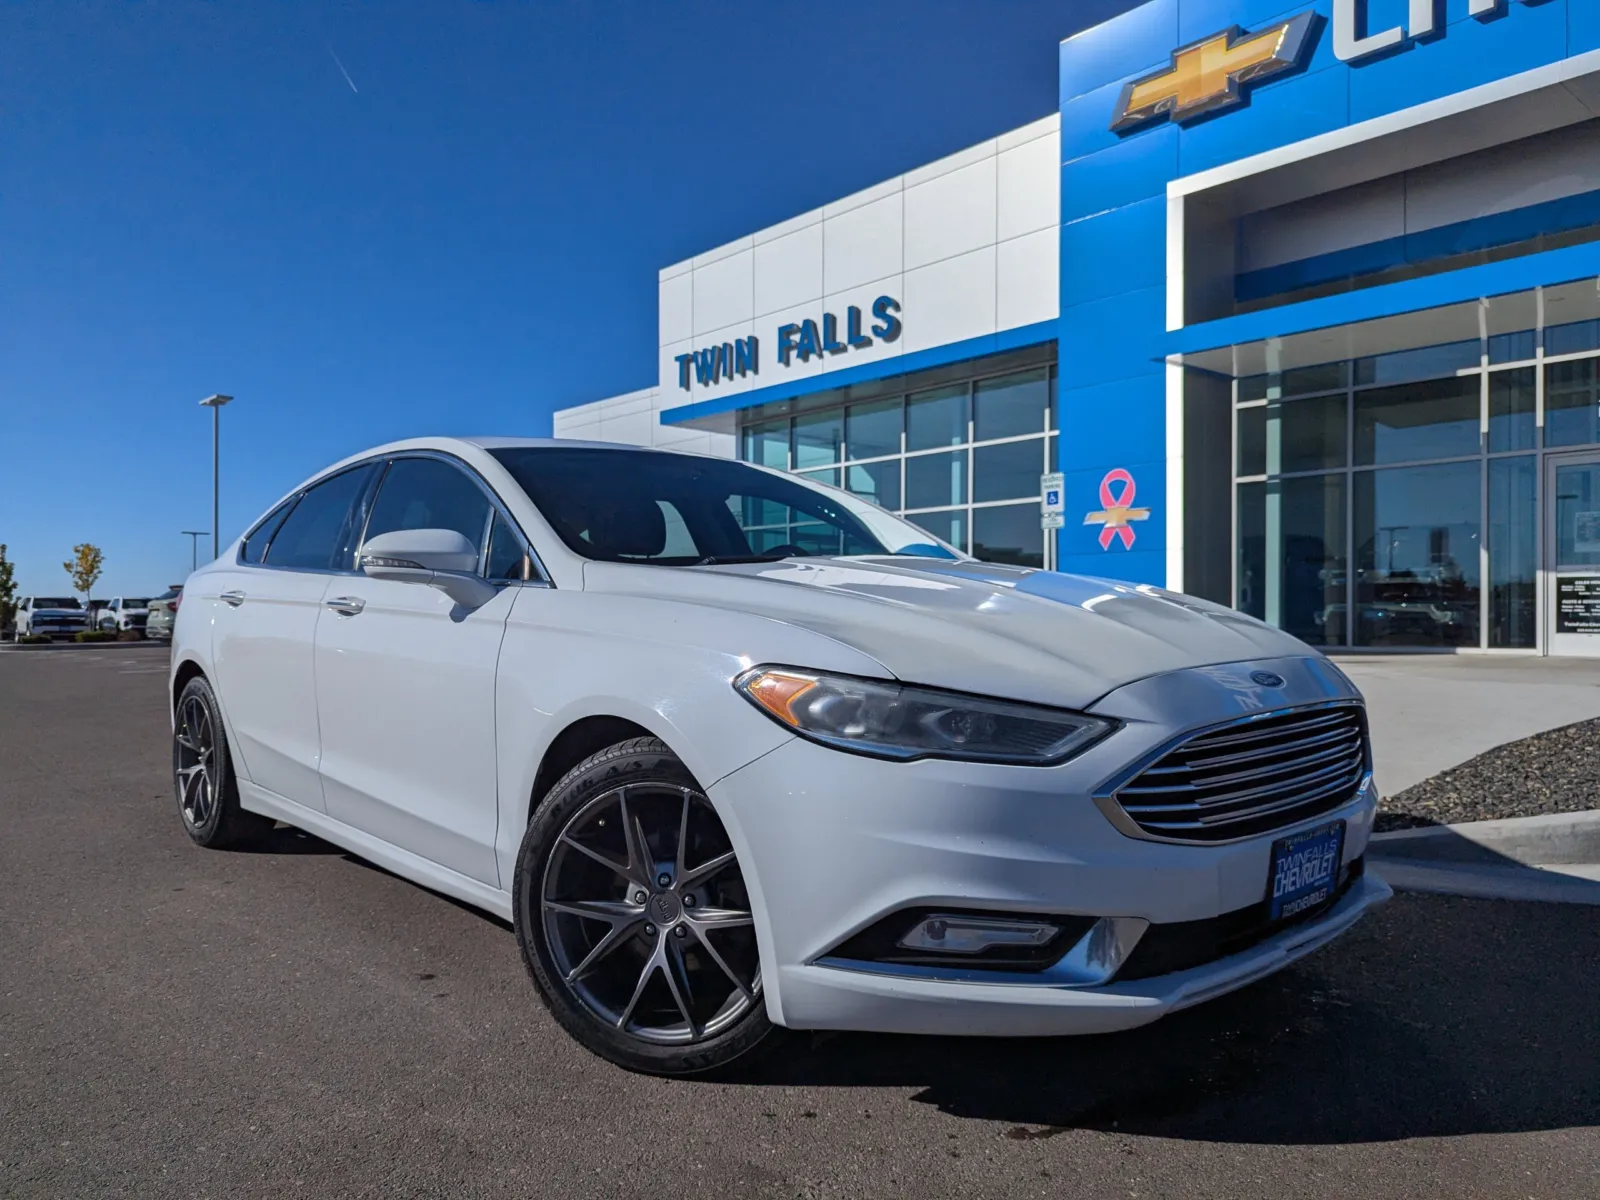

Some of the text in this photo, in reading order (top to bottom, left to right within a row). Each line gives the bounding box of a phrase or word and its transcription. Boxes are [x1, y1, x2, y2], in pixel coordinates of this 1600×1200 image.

[674, 295, 902, 392] TWIN FALLS
[1273, 852, 1335, 898] CHEVROLET
